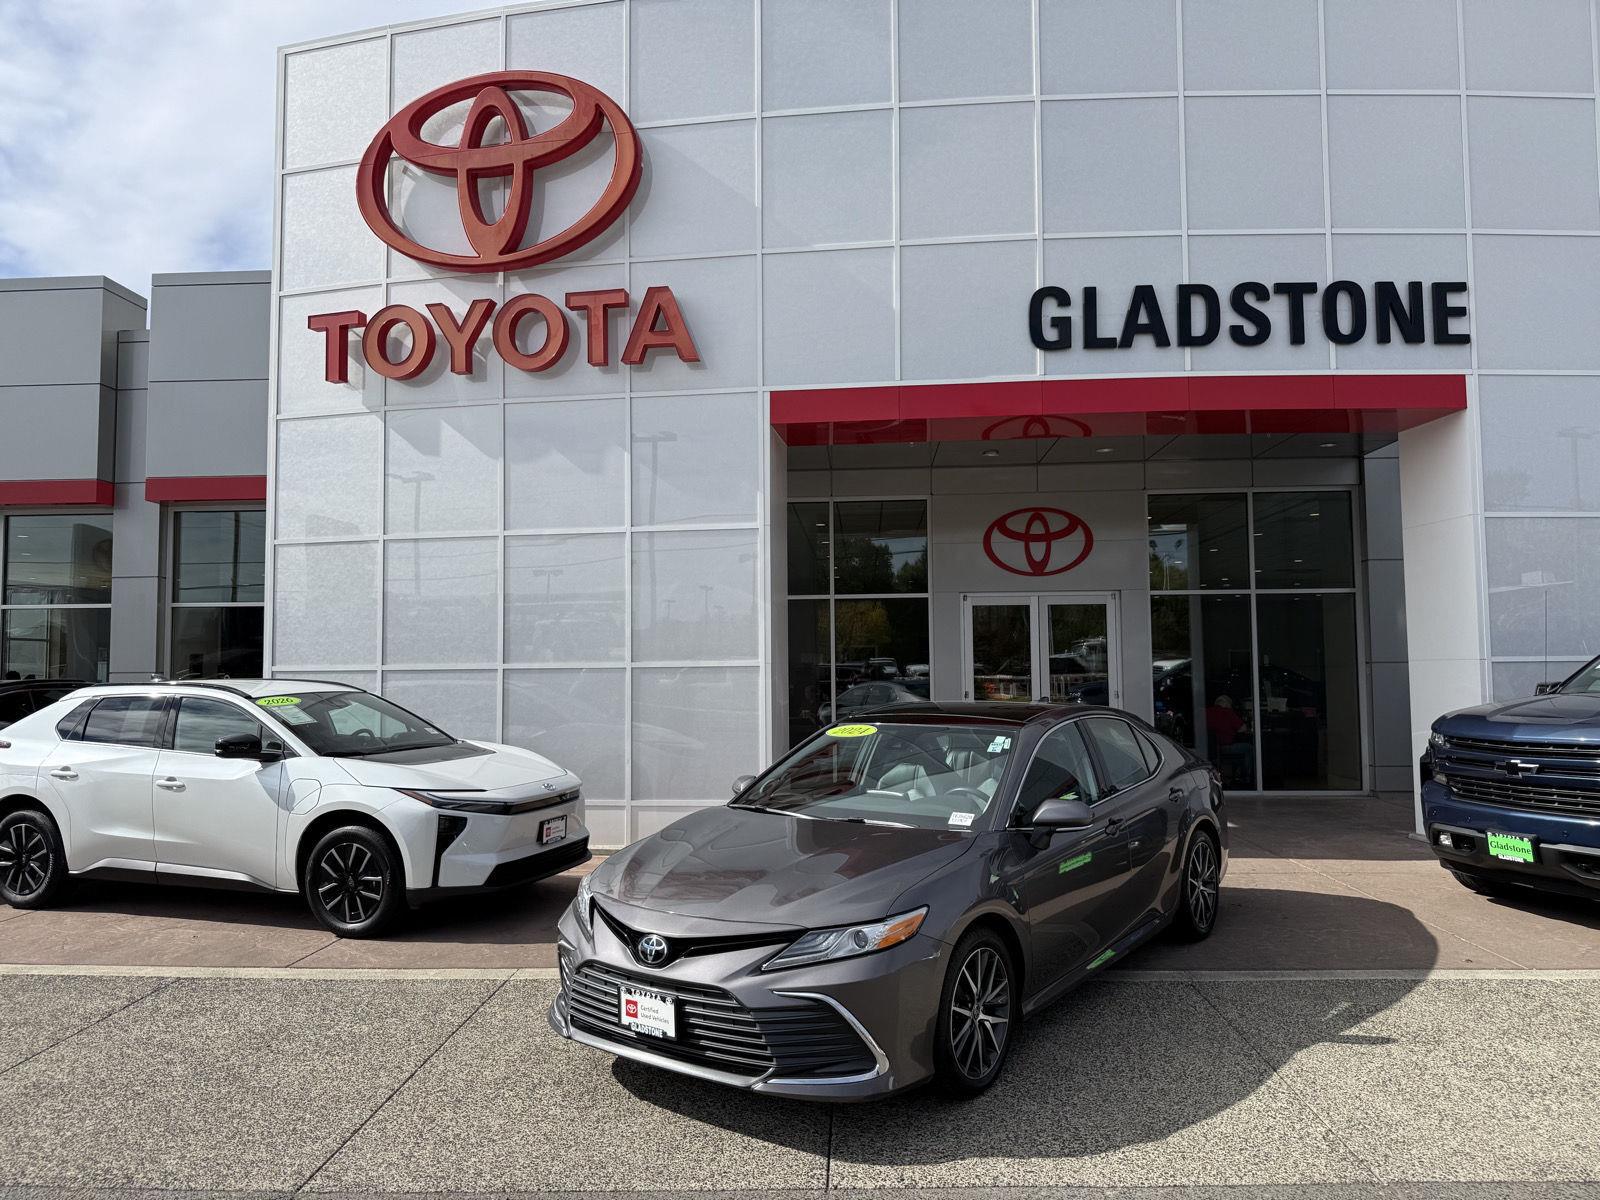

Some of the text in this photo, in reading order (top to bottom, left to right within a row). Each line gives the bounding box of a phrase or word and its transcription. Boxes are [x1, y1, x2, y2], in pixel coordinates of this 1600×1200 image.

[1028, 280, 1471, 350] GLADSTONE
[307, 285, 700, 384] TOYOTA
[1490, 841, 1531, 854] Gladstone
[630, 989, 661, 1001] TOYOTA
[640, 1005, 659, 1014] Certified
[652, 1015, 669, 1024] Vehicles
[630, 1022, 663, 1038] GLADSTONE
